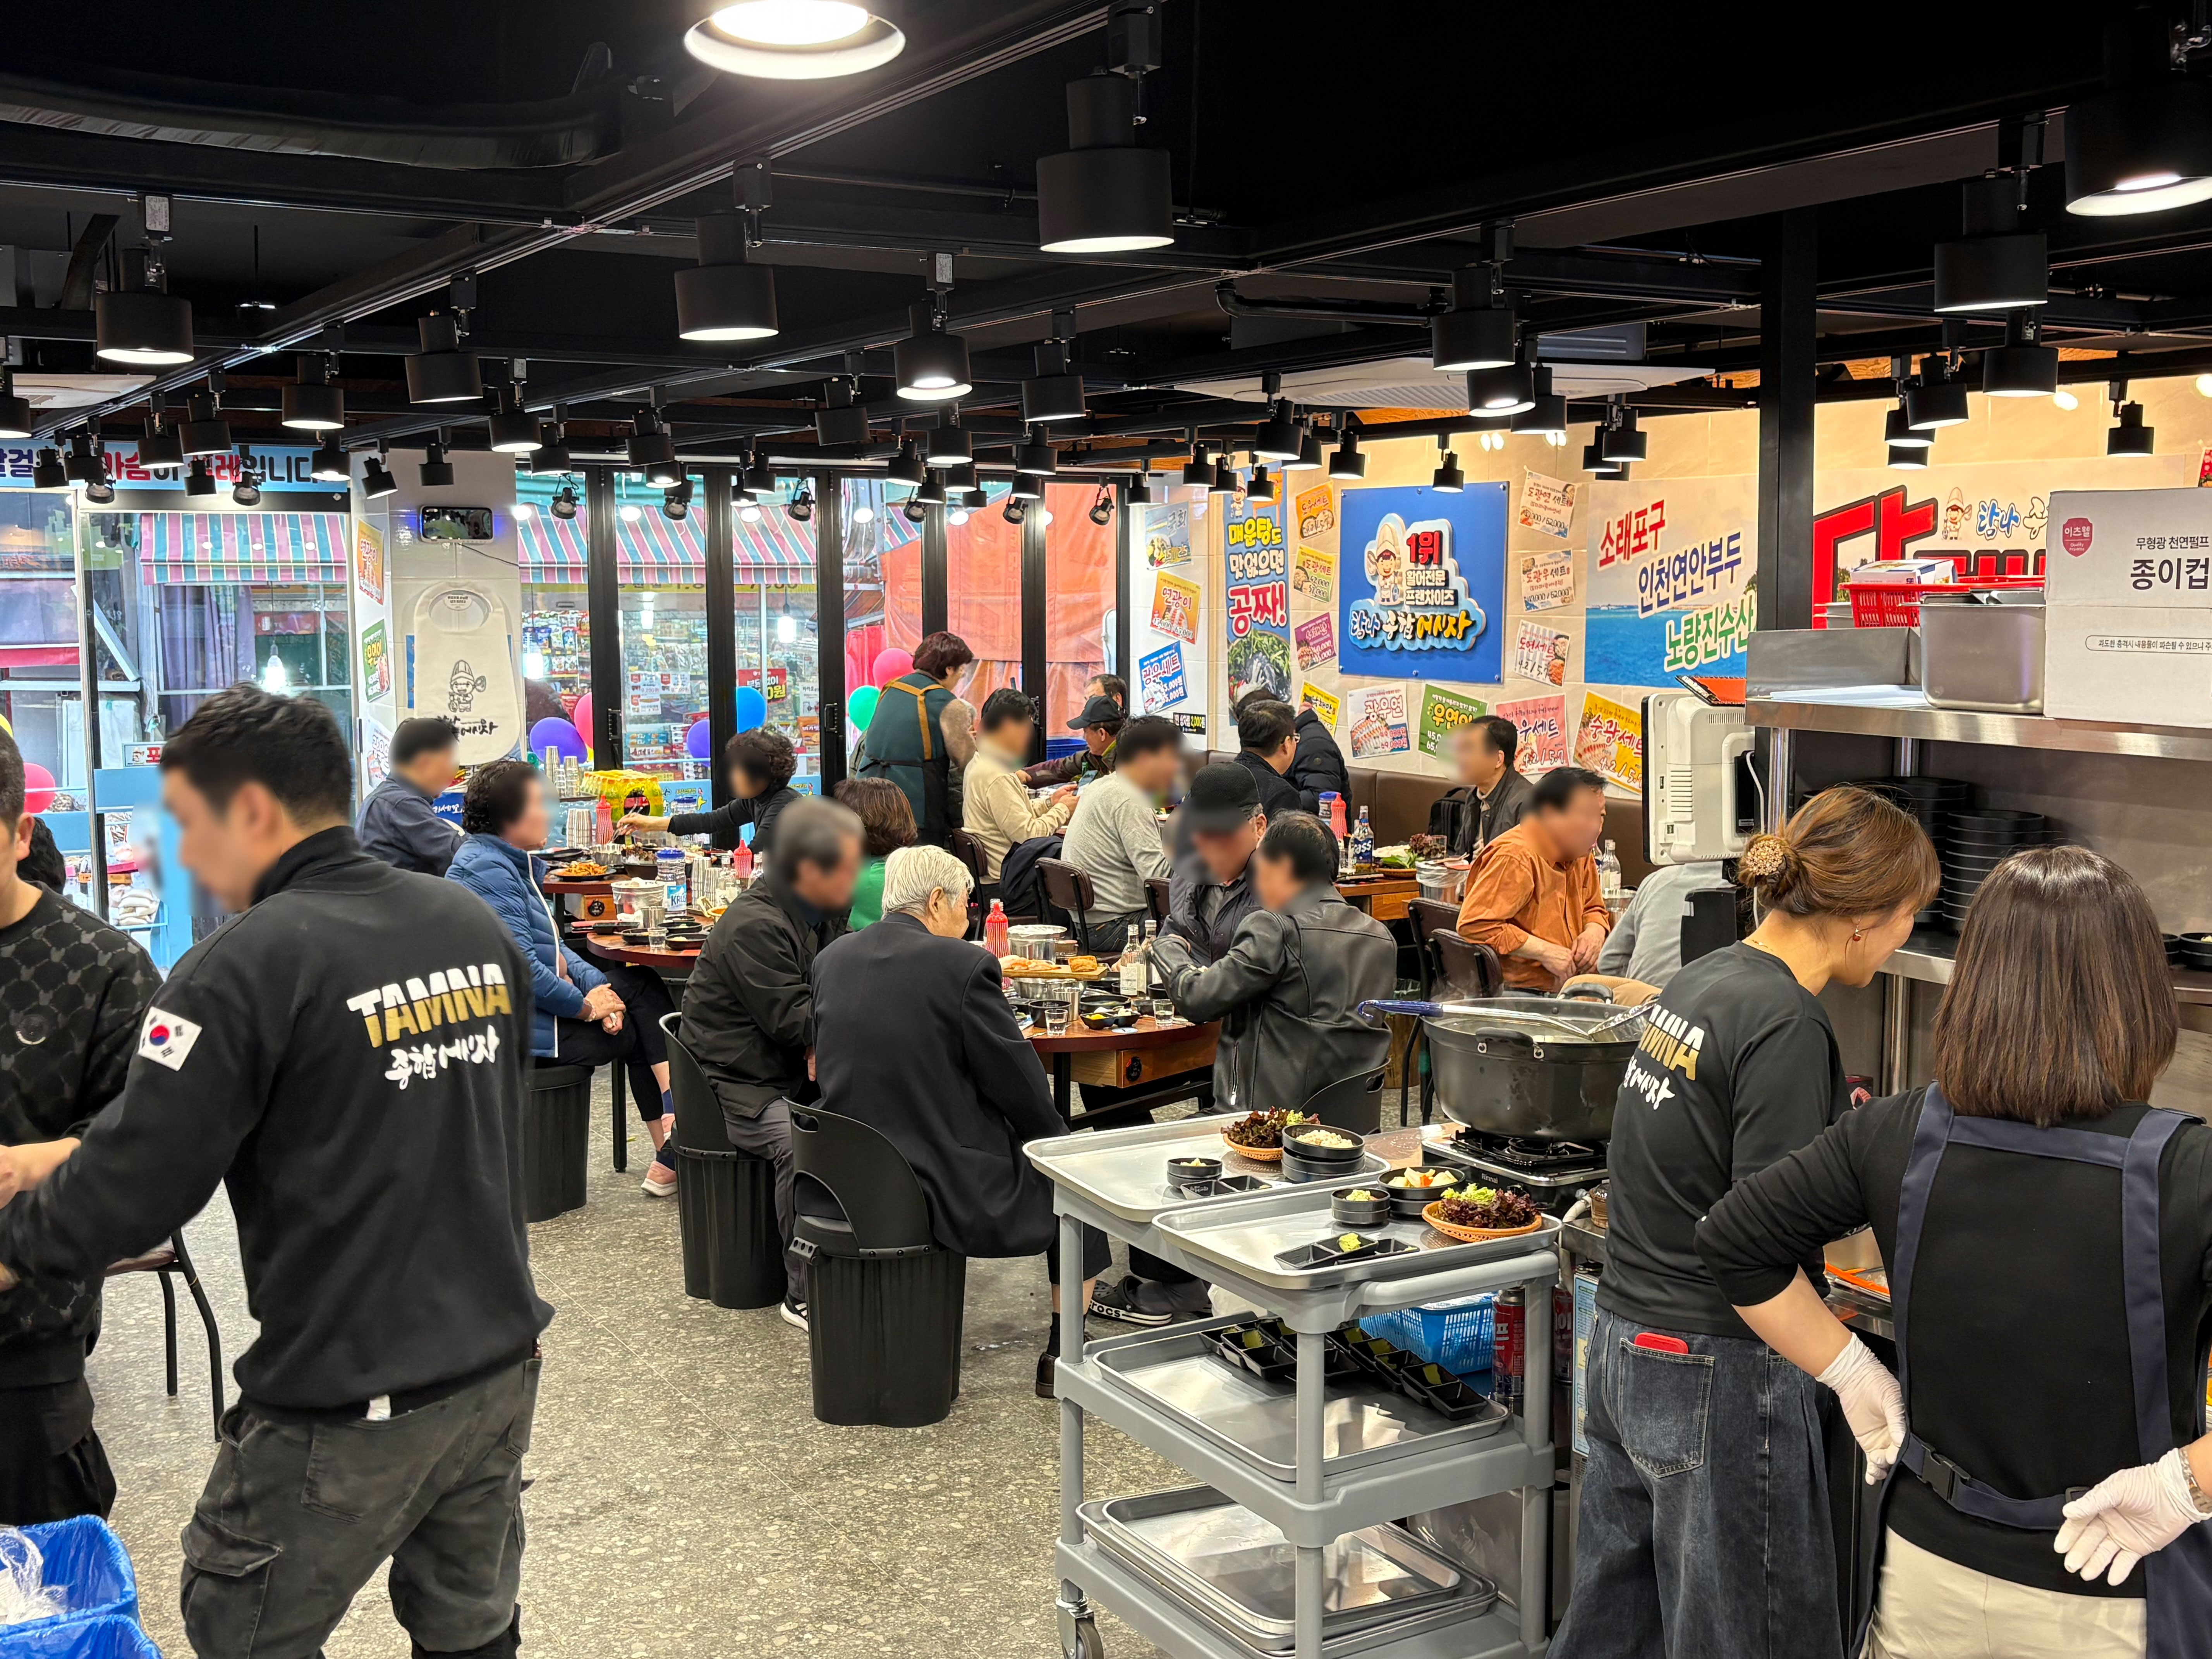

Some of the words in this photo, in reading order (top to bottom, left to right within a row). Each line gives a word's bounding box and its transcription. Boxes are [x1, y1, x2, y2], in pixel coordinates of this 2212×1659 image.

[2023, 496, 2048, 540] 종
[2064, 526, 2090, 538] 이츠웰
[1228, 518, 1282, 547] 매운탕도
[1599, 499, 1665, 567] 소래포구
[2136, 537, 2166, 550] 무형광
[2168, 536, 2210, 550] 천연펄프
[1406, 530, 1442, 565] 1위
[1230, 550, 1284, 580] 맛없으면
[1406, 570, 1446, 587] 활어전문
[1550, 565, 1566, 578] 세트
[1638, 531, 1742, 614] 인천연안부두
[2130, 558, 2209, 590] 종이컵
[1162, 587, 1192, 610] 연광이
[1229, 582, 1286, 636] 공짜!
[1667, 595, 1757, 668] 노량진수산
[1518, 637, 1555, 658] 도연세트
[2178, 642, 2185, 650] 수
[2186, 642, 2203, 651] 있으니
[2205, 642, 2212, 651] 주
[1142, 653, 1181, 685] 광우세트
[1364, 694, 1403, 722] 광우연
[1427, 730, 1441, 742] 45,0
[1511, 719, 1559, 742] 우세트
[1426, 741, 1437, 753] 65,
[671, 894, 686, 906] KRUS
[347, 963, 512, 1048] TAMNA
[385, 1043, 437, 1090] 종합
